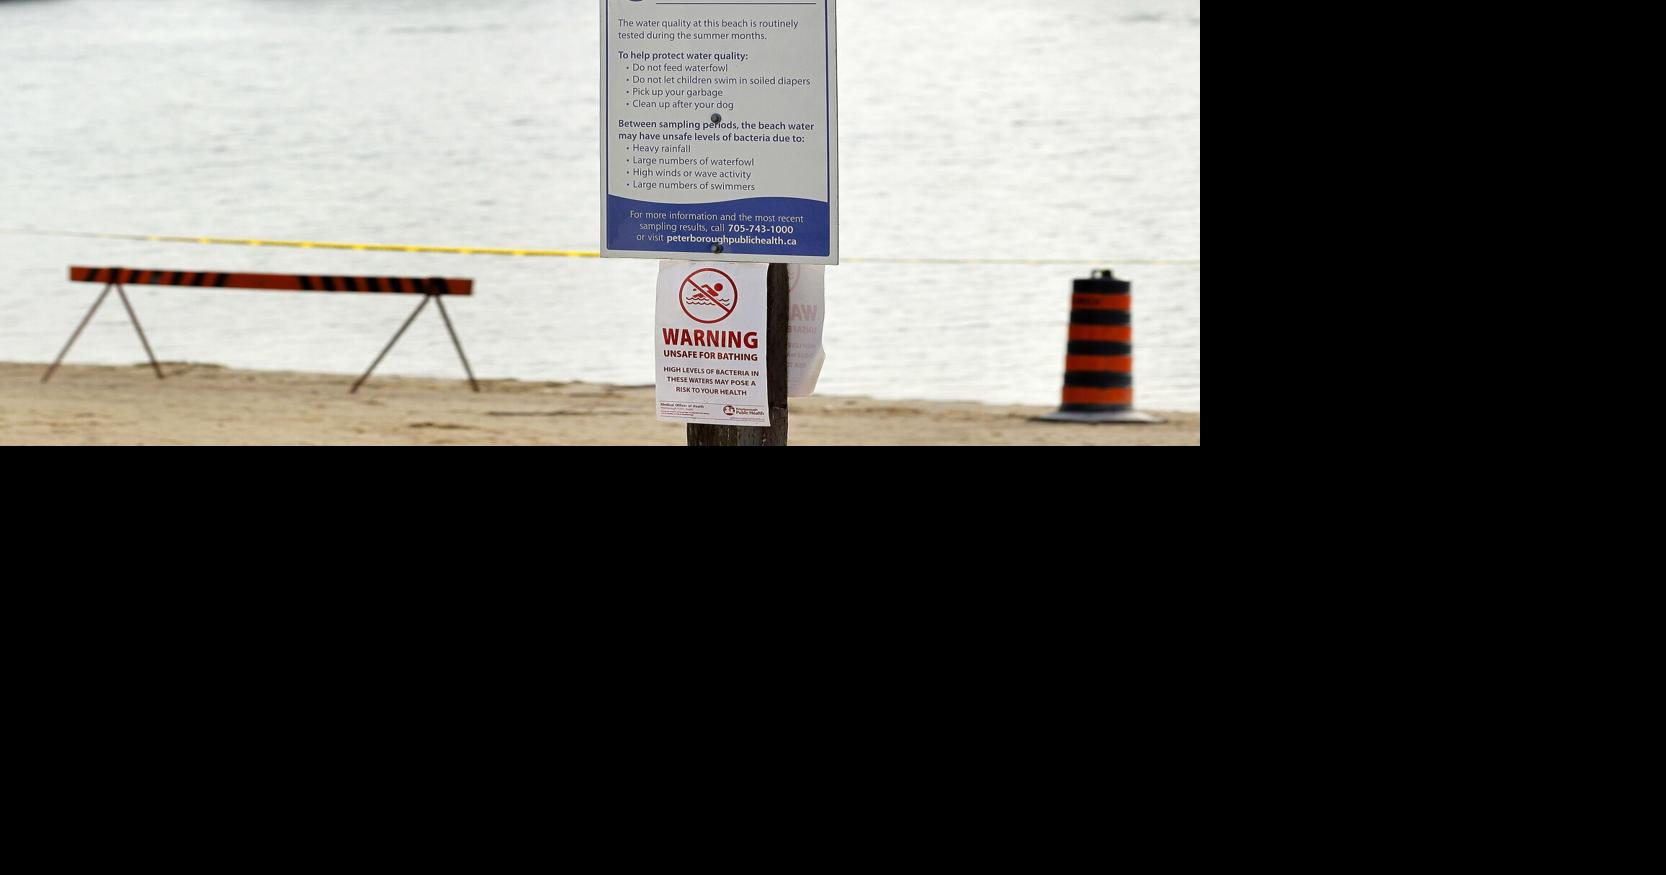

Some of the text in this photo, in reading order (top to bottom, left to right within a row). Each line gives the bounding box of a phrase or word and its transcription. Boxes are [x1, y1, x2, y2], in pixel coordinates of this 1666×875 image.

[618, 19, 634, 27] The
[662, 20, 691, 28] quality
[693, 20, 702, 28] at
[703, 19, 720, 28] this
[721, 19, 748, 28] beach
[750, 20, 757, 28] is
[759, 20, 798, 29] routinely
[618, 31, 644, 39] tested
[646, 31, 675, 41] during
[677, 32, 692, 40] the
[731, 32, 767, 40] months.
[618, 51, 629, 59] To
[630, 52, 650, 61] help
[652, 52, 685, 61] protect
[714, 52, 748, 61] quality:
[632, 64, 645, 72] Do
[663, 63, 683, 72] feed
[685, 64, 728, 72] waterfowl
[664, 76, 675, 84] let
[677, 76, 712, 85] children
[714, 77, 738, 85] swim
[740, 77, 748, 85] in
[750, 77, 776, 85] soiled
[777, 77, 811, 87] diapers
[632, 88, 723, 98] Pick up your garbage
[632, 100, 734, 111] Clean up after your dog
[618, 120, 657, 128] Between
[659, 120, 700, 131] sampling
[702, 121, 739, 131] periods,
[741, 122, 756, 130] the
[758, 122, 786, 130] beach
[618, 132, 805, 143] may have unsafe levels of bacteria due to:
[633, 145, 659, 154] Heavy
[633, 157, 657, 166] Large
[699, 157, 709, 165] of
[710, 158, 754, 166] waterfowl
[633, 169, 653, 178] High
[655, 169, 681, 177] winds
[719, 170, 751, 179] activity
[633, 181, 657, 190] Large
[699, 181, 709, 189] of
[711, 183, 755, 191] swimmers
[630, 211, 643, 219] For
[669, 211, 718, 221] information
[720, 213, 736, 221] and
[738, 213, 752, 221] the
[754, 214, 775, 222] most
[777, 215, 803, 223] recent
[640, 222, 793, 234] sampling results, call 705-743-1000
[647, 234, 664, 242] visit
[666, 234, 797, 245] peterboroughpublichealth.ca
[662, 328, 758, 348] WARNING
[664, 350, 758, 361] UNSAFE FOR BATHING
